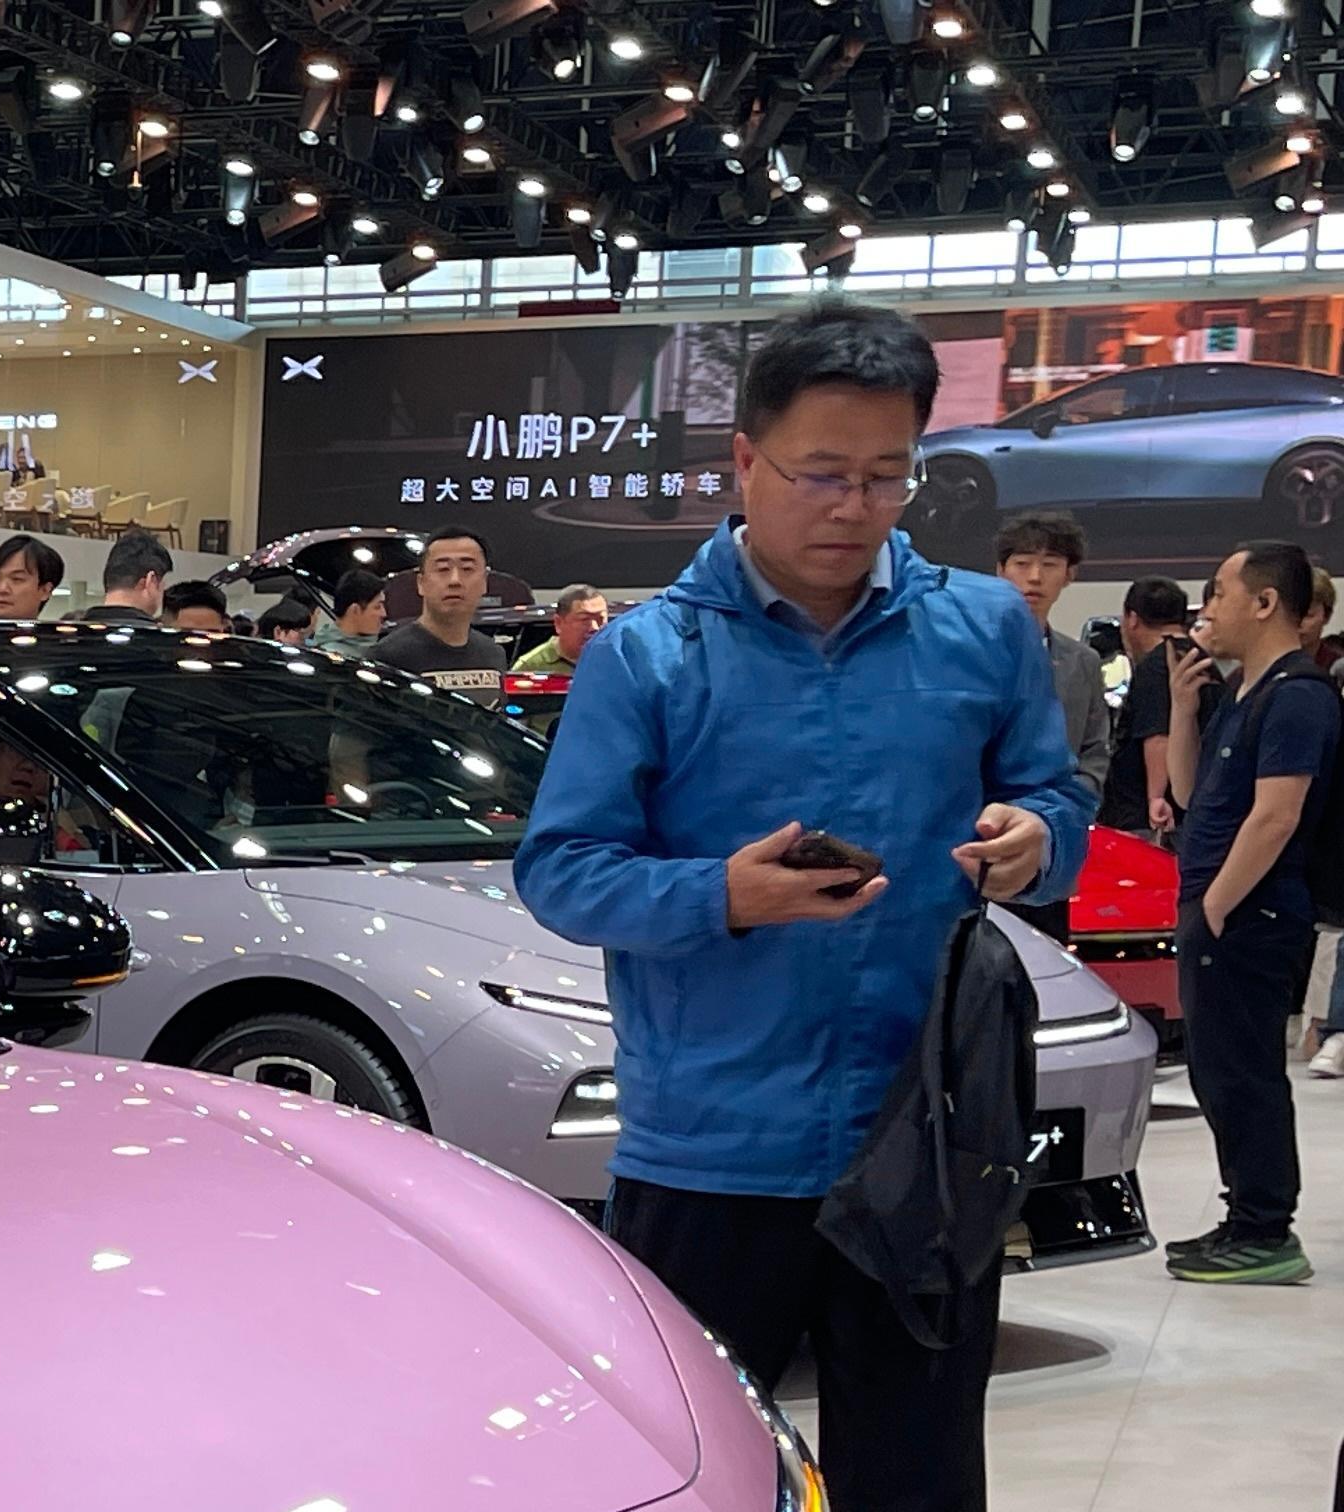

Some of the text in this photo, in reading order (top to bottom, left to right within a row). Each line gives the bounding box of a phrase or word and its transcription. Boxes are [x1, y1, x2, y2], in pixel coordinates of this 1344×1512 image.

[466, 413, 658, 461] 小鹏P7+
[399, 470, 722, 504] 超大空间AI智能轿车
